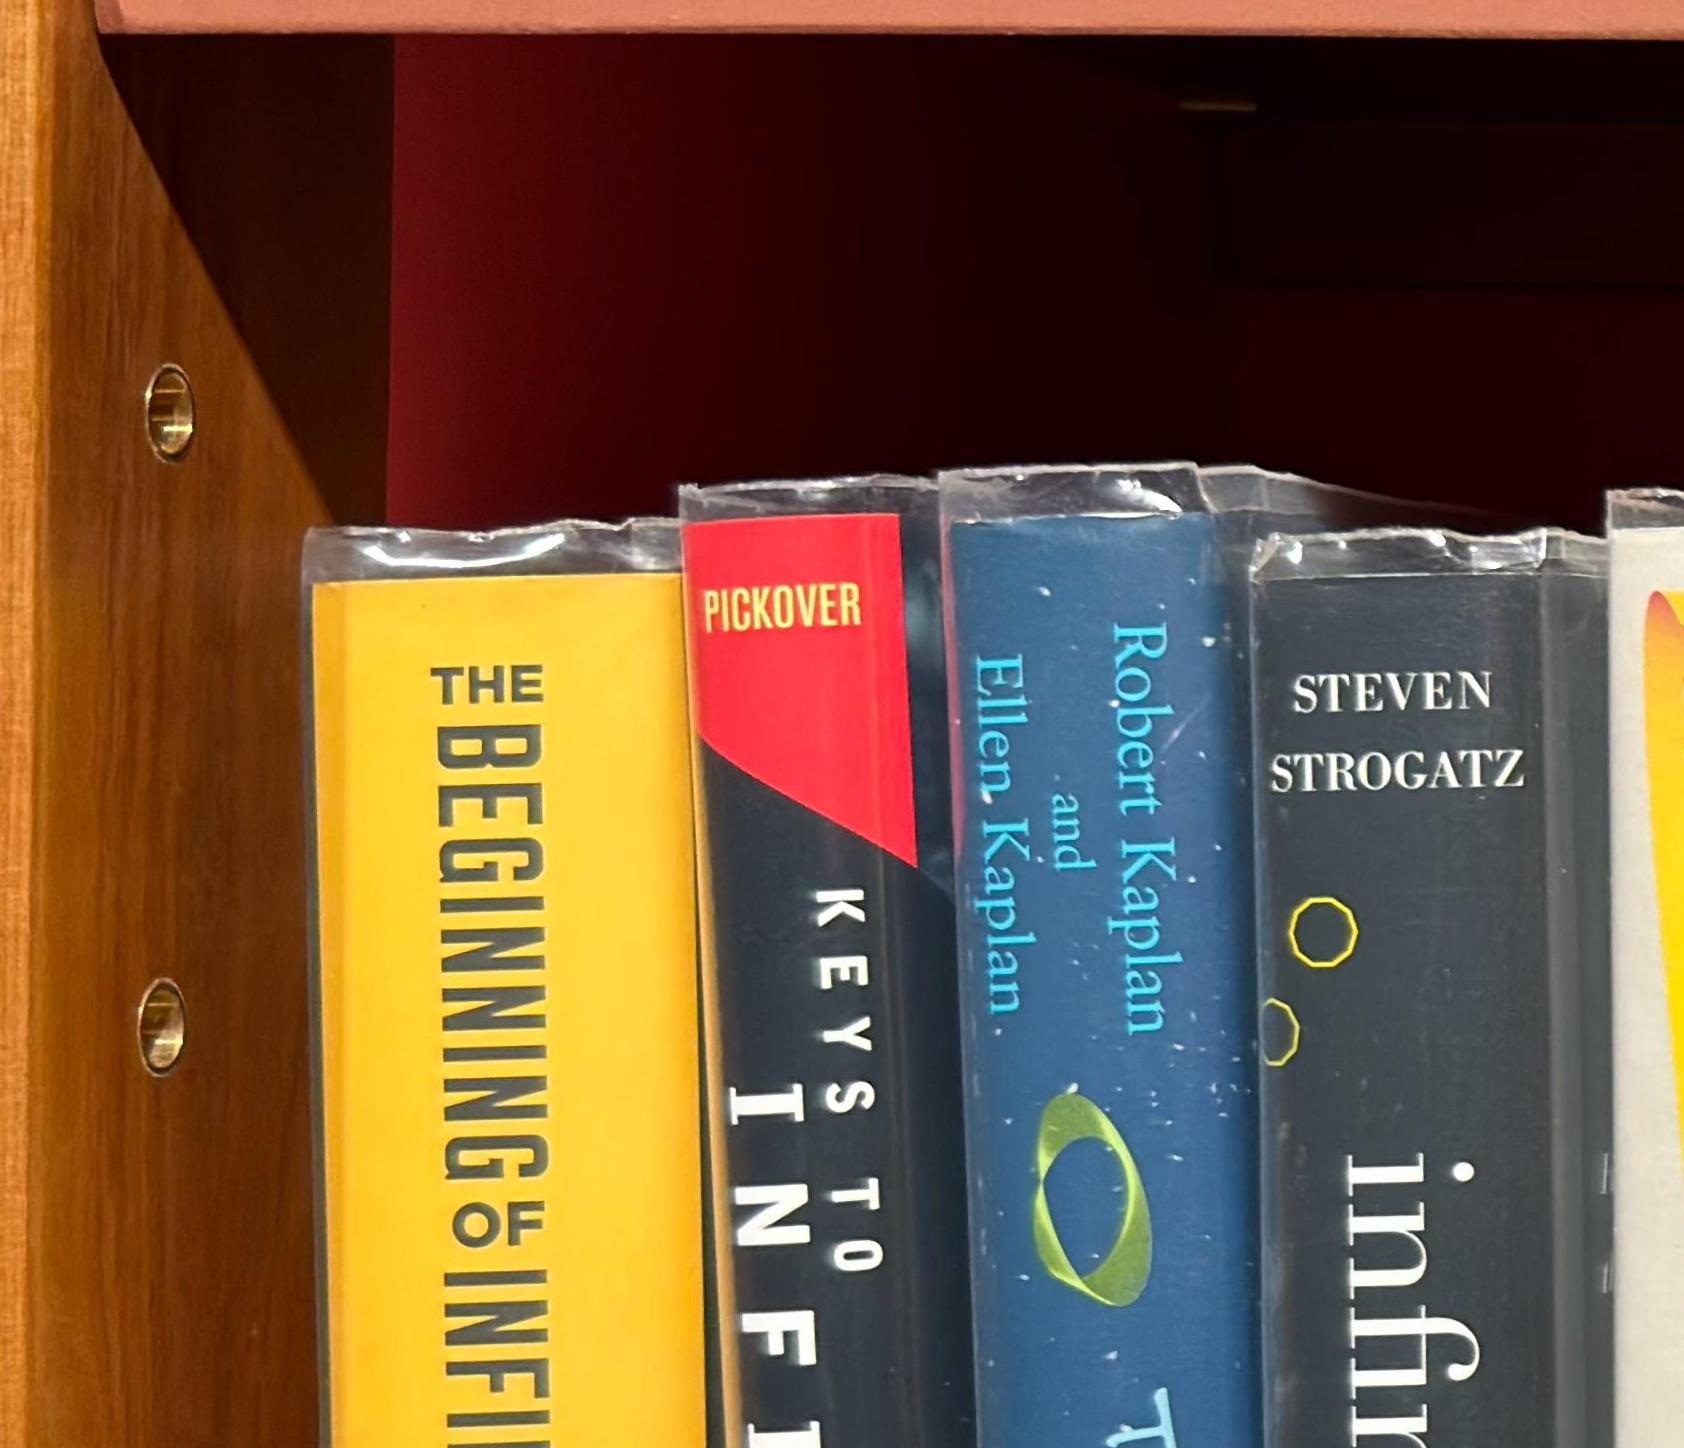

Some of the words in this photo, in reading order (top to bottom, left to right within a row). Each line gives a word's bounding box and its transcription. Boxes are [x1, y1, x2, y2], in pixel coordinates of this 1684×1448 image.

[705, 583, 860, 631] PICKOVER
[430, 665, 543, 705] THE
[976, 654, 1028, 799] Ellen
[1109, 622, 1170, 815] Robert
[1293, 671, 1491, 713] STEVEN
[1272, 750, 1523, 792] STROGATZ
[1052, 794, 1096, 870] and
[437, 724, 548, 1180] BEGINNING
[974, 818, 1036, 1013] Kaplan
[1110, 838, 1182, 1035] Kaplan
[813, 889, 875, 1113] KEYS
[452, 1201, 544, 1248] OF
[828, 1178, 883, 1271] TO
